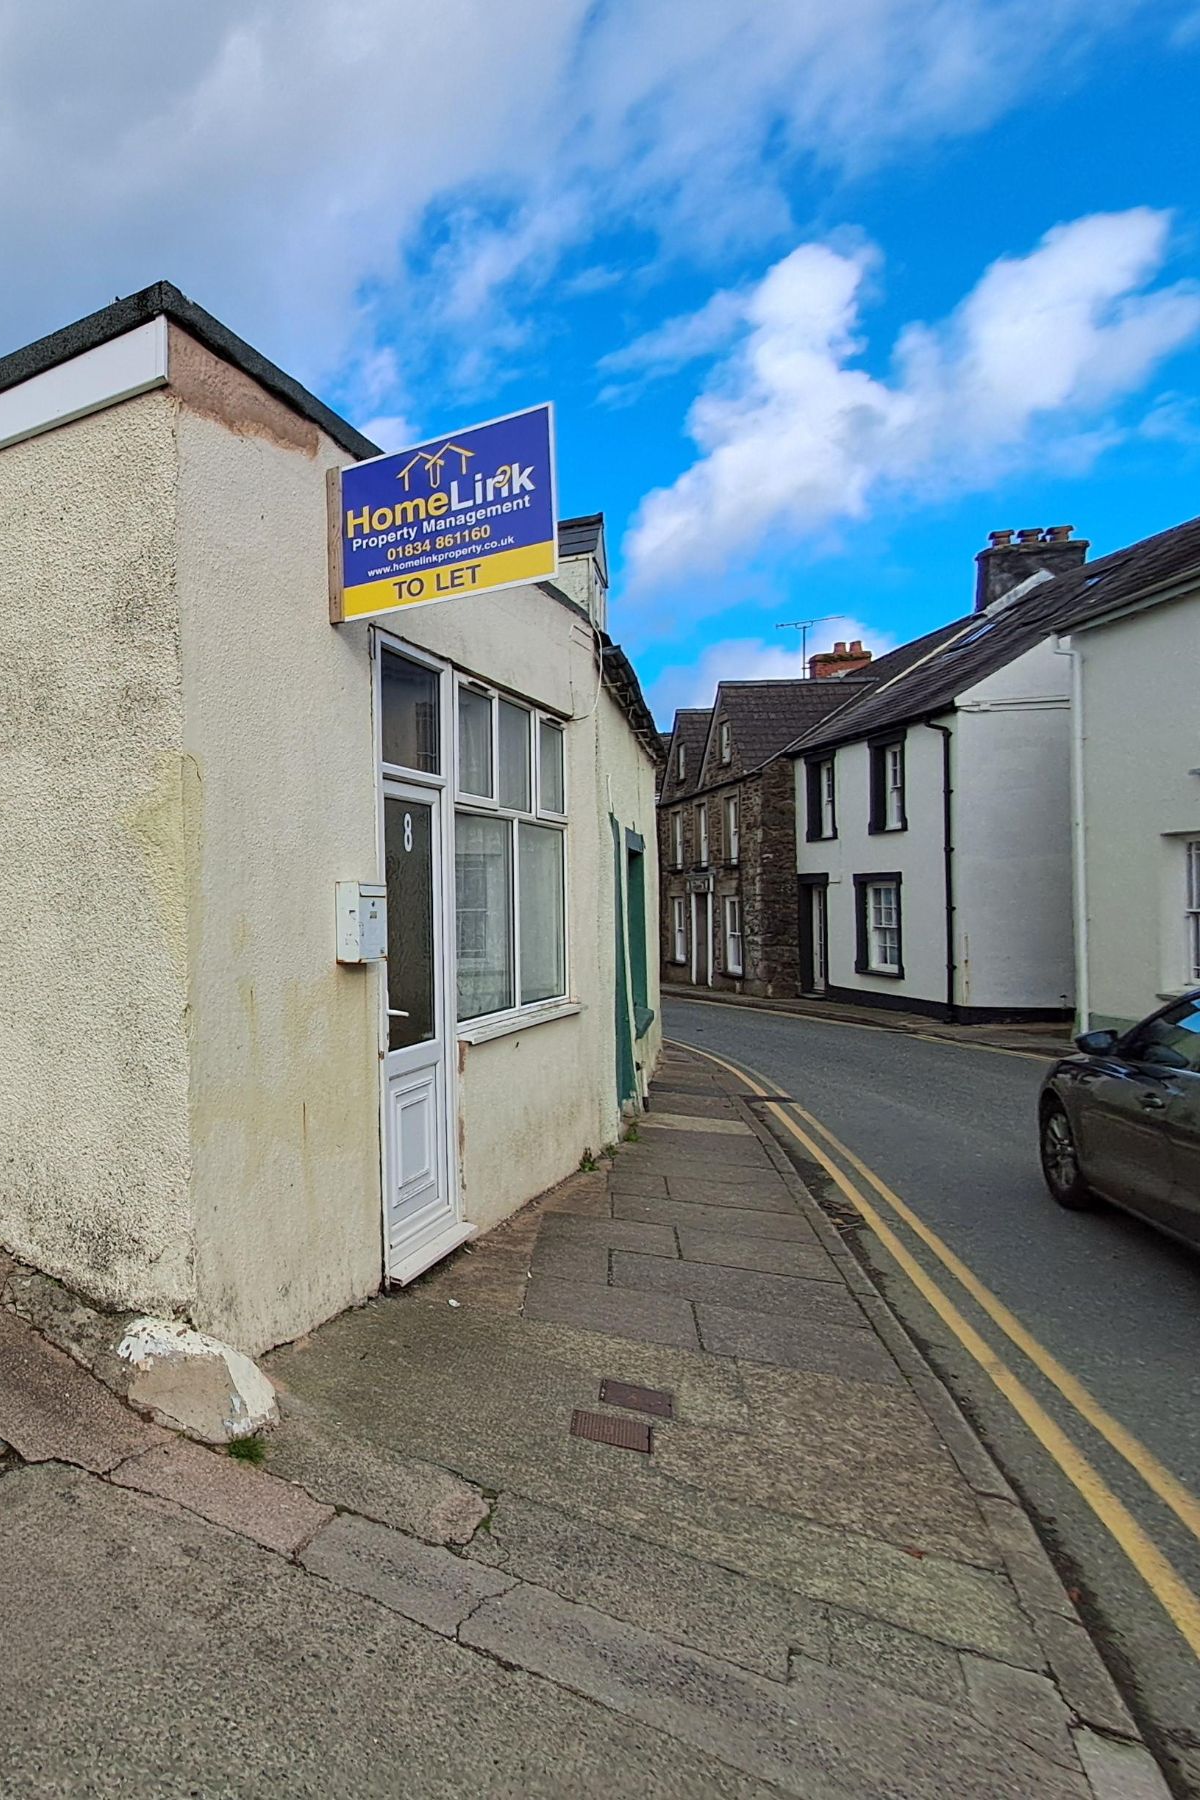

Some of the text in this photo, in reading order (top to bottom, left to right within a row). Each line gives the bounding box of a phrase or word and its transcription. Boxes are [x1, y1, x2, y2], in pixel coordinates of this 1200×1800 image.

[346, 462, 536, 538] HomeLink
[352, 494, 531, 551] Property Management
[387, 524, 491, 561] 01834 861160
[367, 535, 515, 577] www.homelinkproperty.co.uk
[393, 564, 482, 600] TO LET
[403, 812, 413, 852] 8
